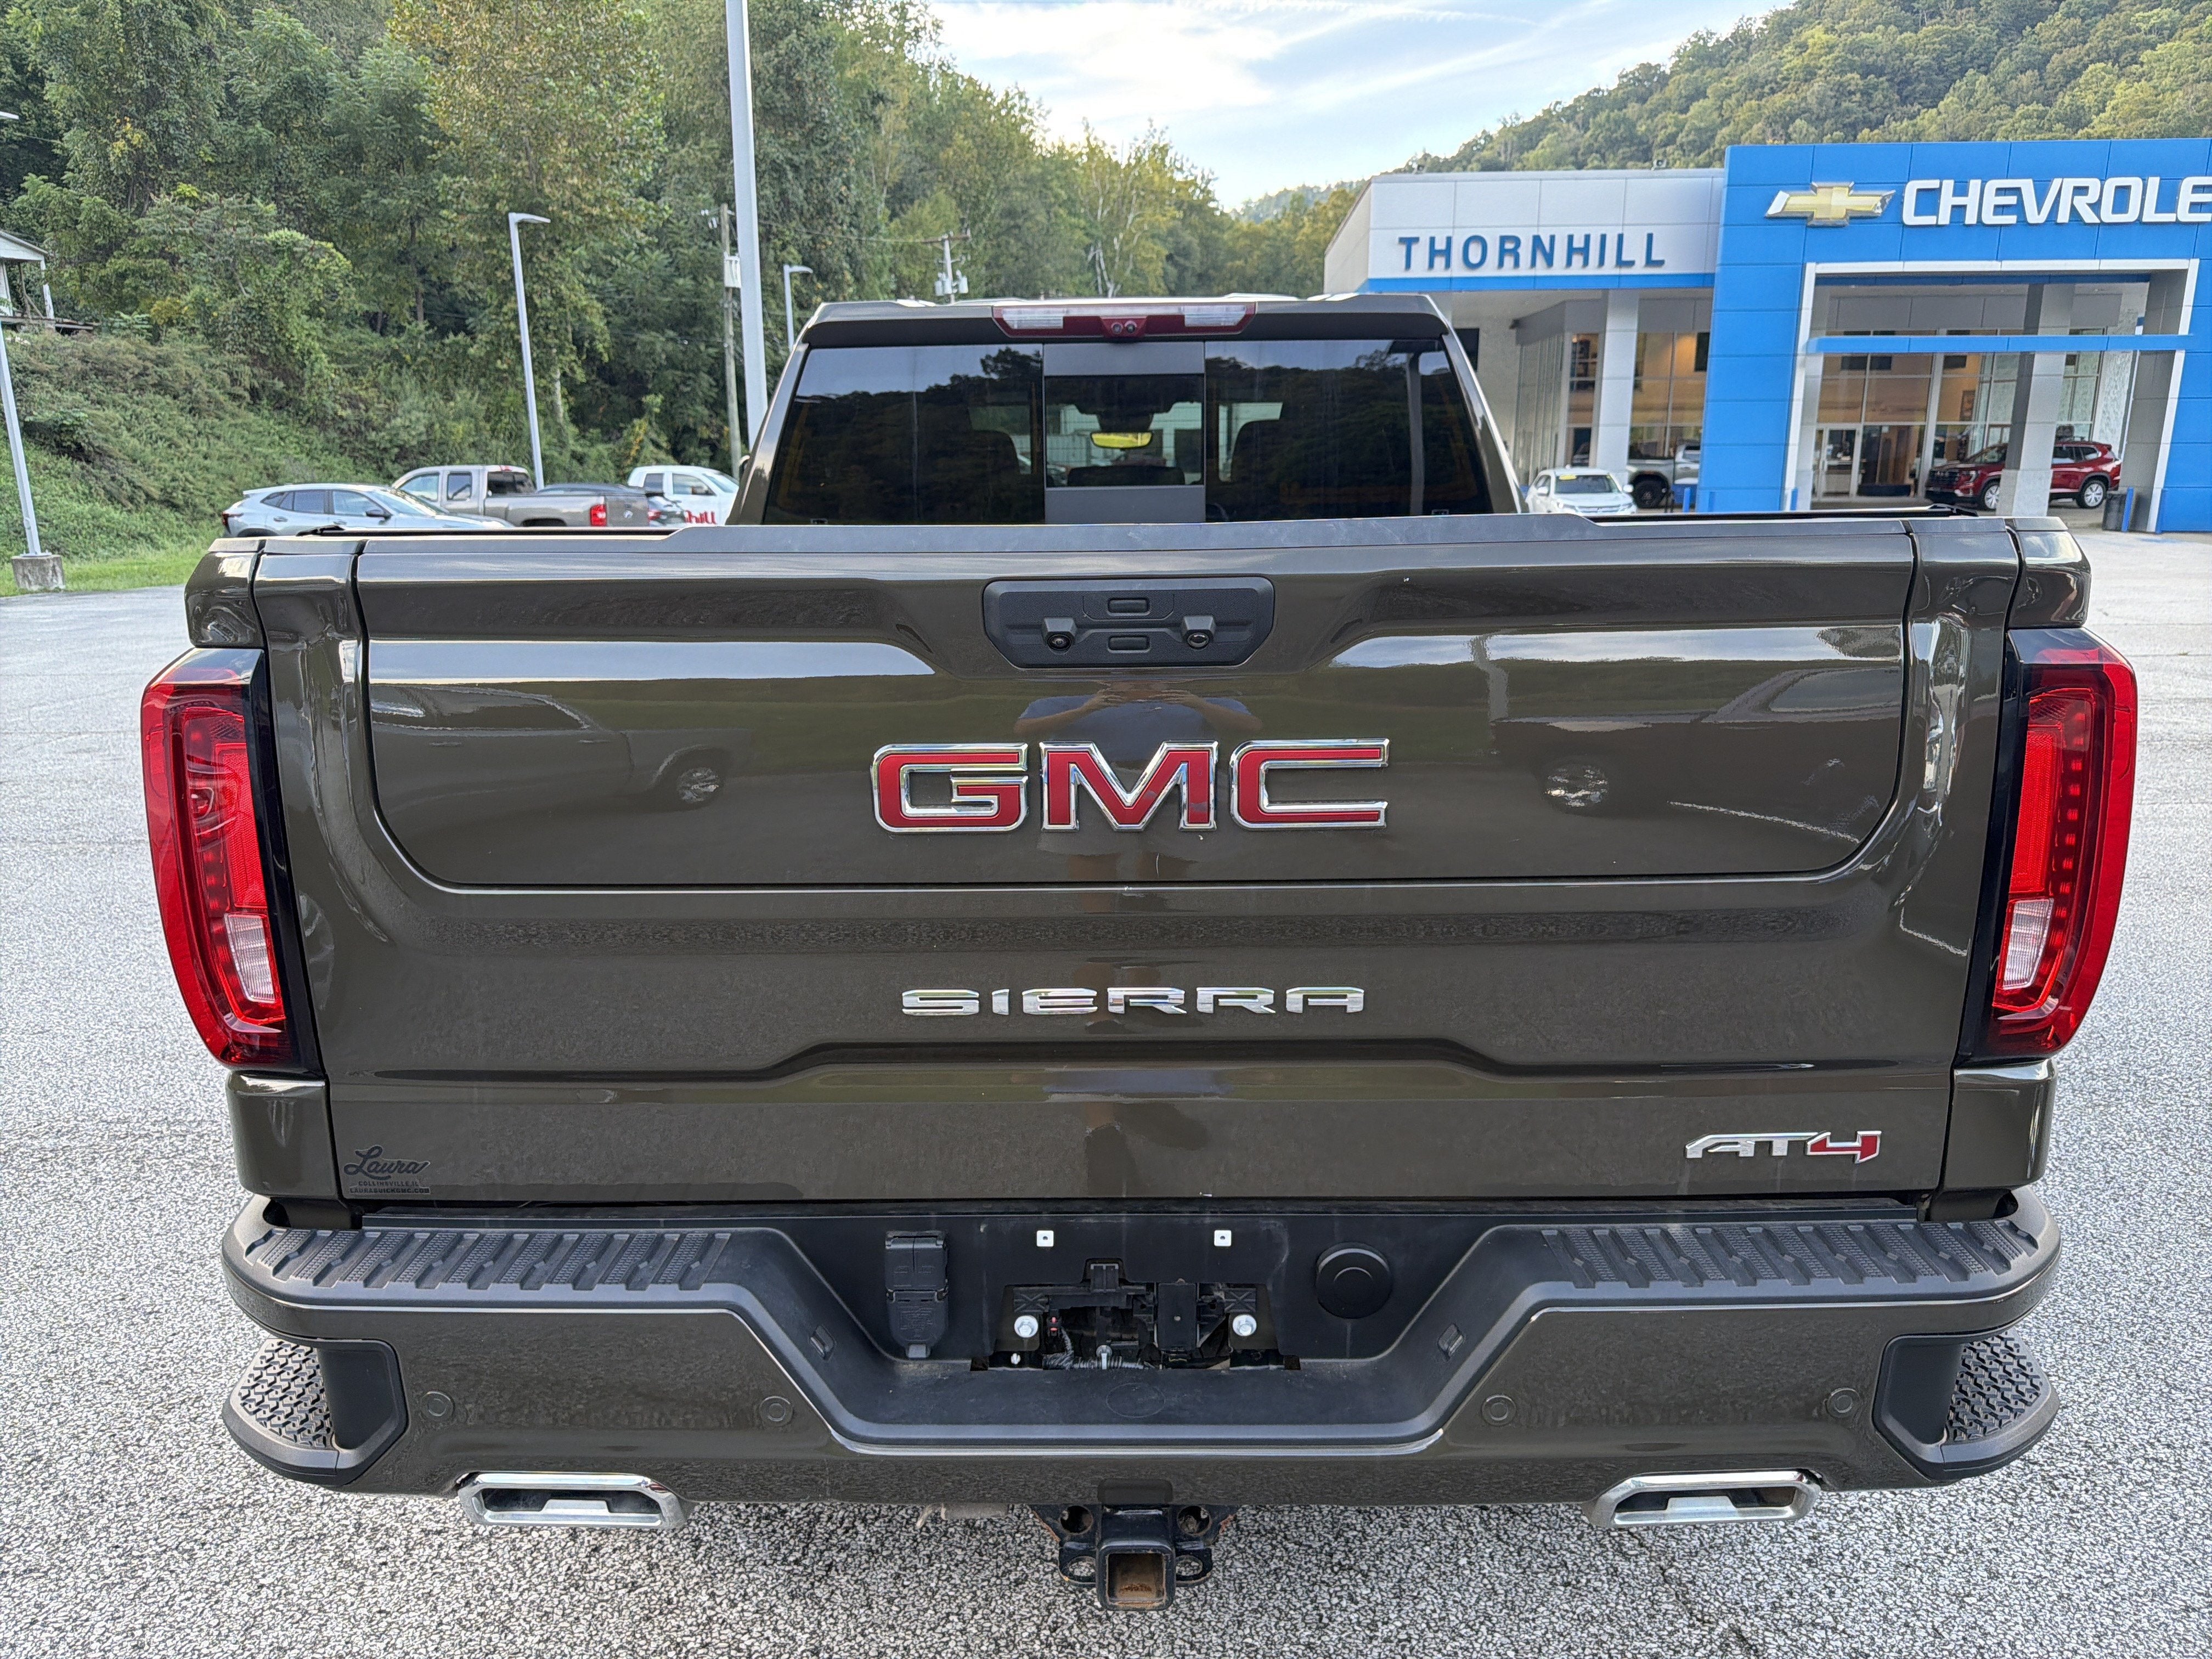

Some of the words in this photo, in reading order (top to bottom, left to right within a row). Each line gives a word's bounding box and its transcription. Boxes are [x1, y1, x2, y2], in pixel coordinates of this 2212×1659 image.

[1902, 177, 2212, 225] CHEVROLE
[1398, 233, 1666, 270] THORNHILL
[871, 738, 1390, 833] GMC
[901, 986, 1365, 1015] SIERRA
[343, 1146, 431, 1180] Laura
[1685, 1130, 1882, 1164] AT4
